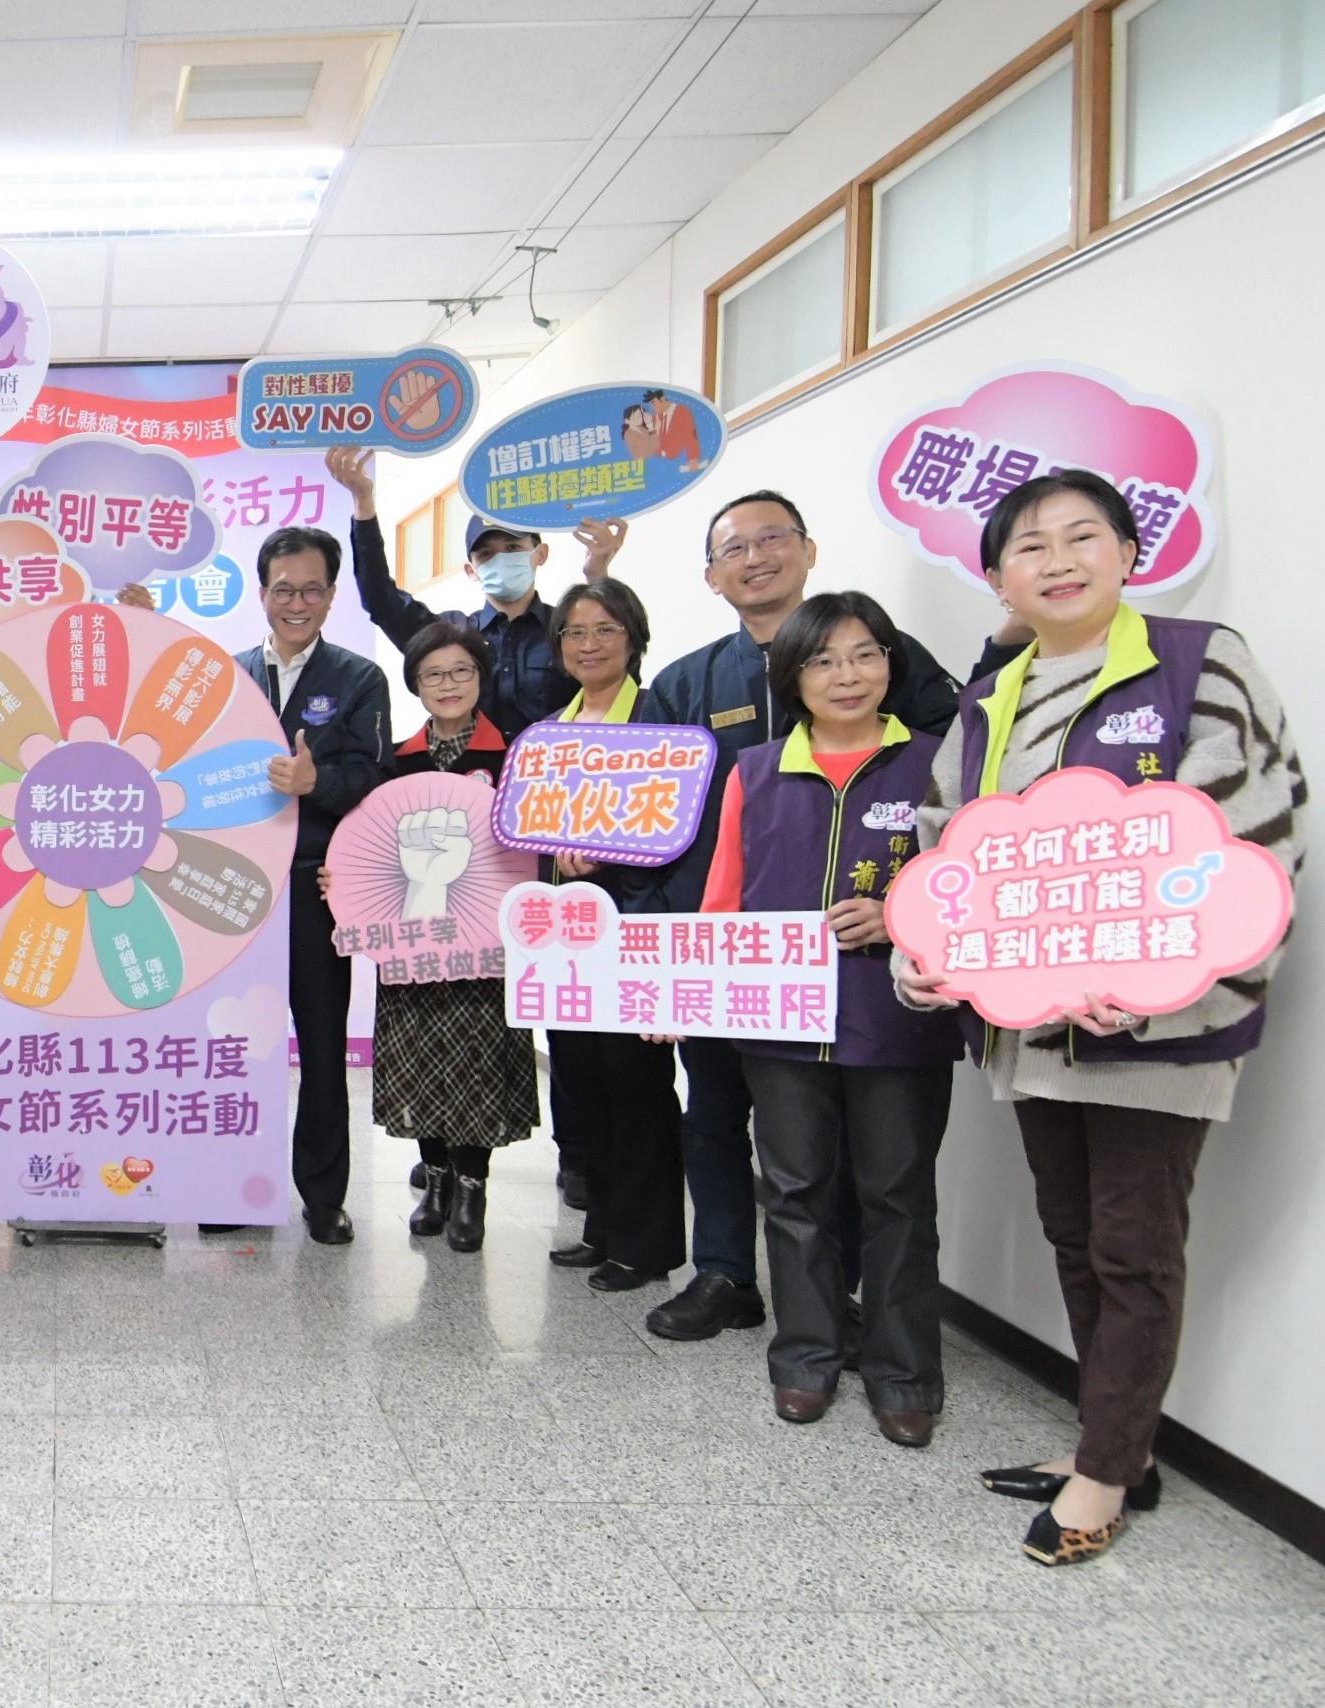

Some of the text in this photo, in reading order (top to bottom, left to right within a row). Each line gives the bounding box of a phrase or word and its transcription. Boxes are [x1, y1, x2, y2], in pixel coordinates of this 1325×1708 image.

[264, 373, 353, 397] 對性騷擾
[254, 405, 372, 432] SAY NO
[487, 425, 612, 478] 增訂權勢
[203, 475, 324, 528] 活力
[486, 458, 646, 511] 性騷擾類型
[898, 430, 1181, 568] 職場權
[11, 492, 190, 549] 性別平等
[69, 614, 85, 702] 創業促進計畫
[91, 613, 107, 687] 女力展翅就
[172, 658, 223, 726] 週六影展
[30, 784, 145, 812] 彰化女力
[516, 776, 679, 838] 做伙來
[30, 821, 145, 850] 精彩活力
[975, 813, 1170, 873] 任何性別
[995, 868, 1144, 920] 都可能
[335, 917, 458, 953] 性別平等
[518, 897, 830, 967] 夢想 無關性別
[384, 946, 506, 983] 由我做起
[516, 960, 829, 1033] 自由 發展無限
[28, 1153, 80, 1189] 彰化
